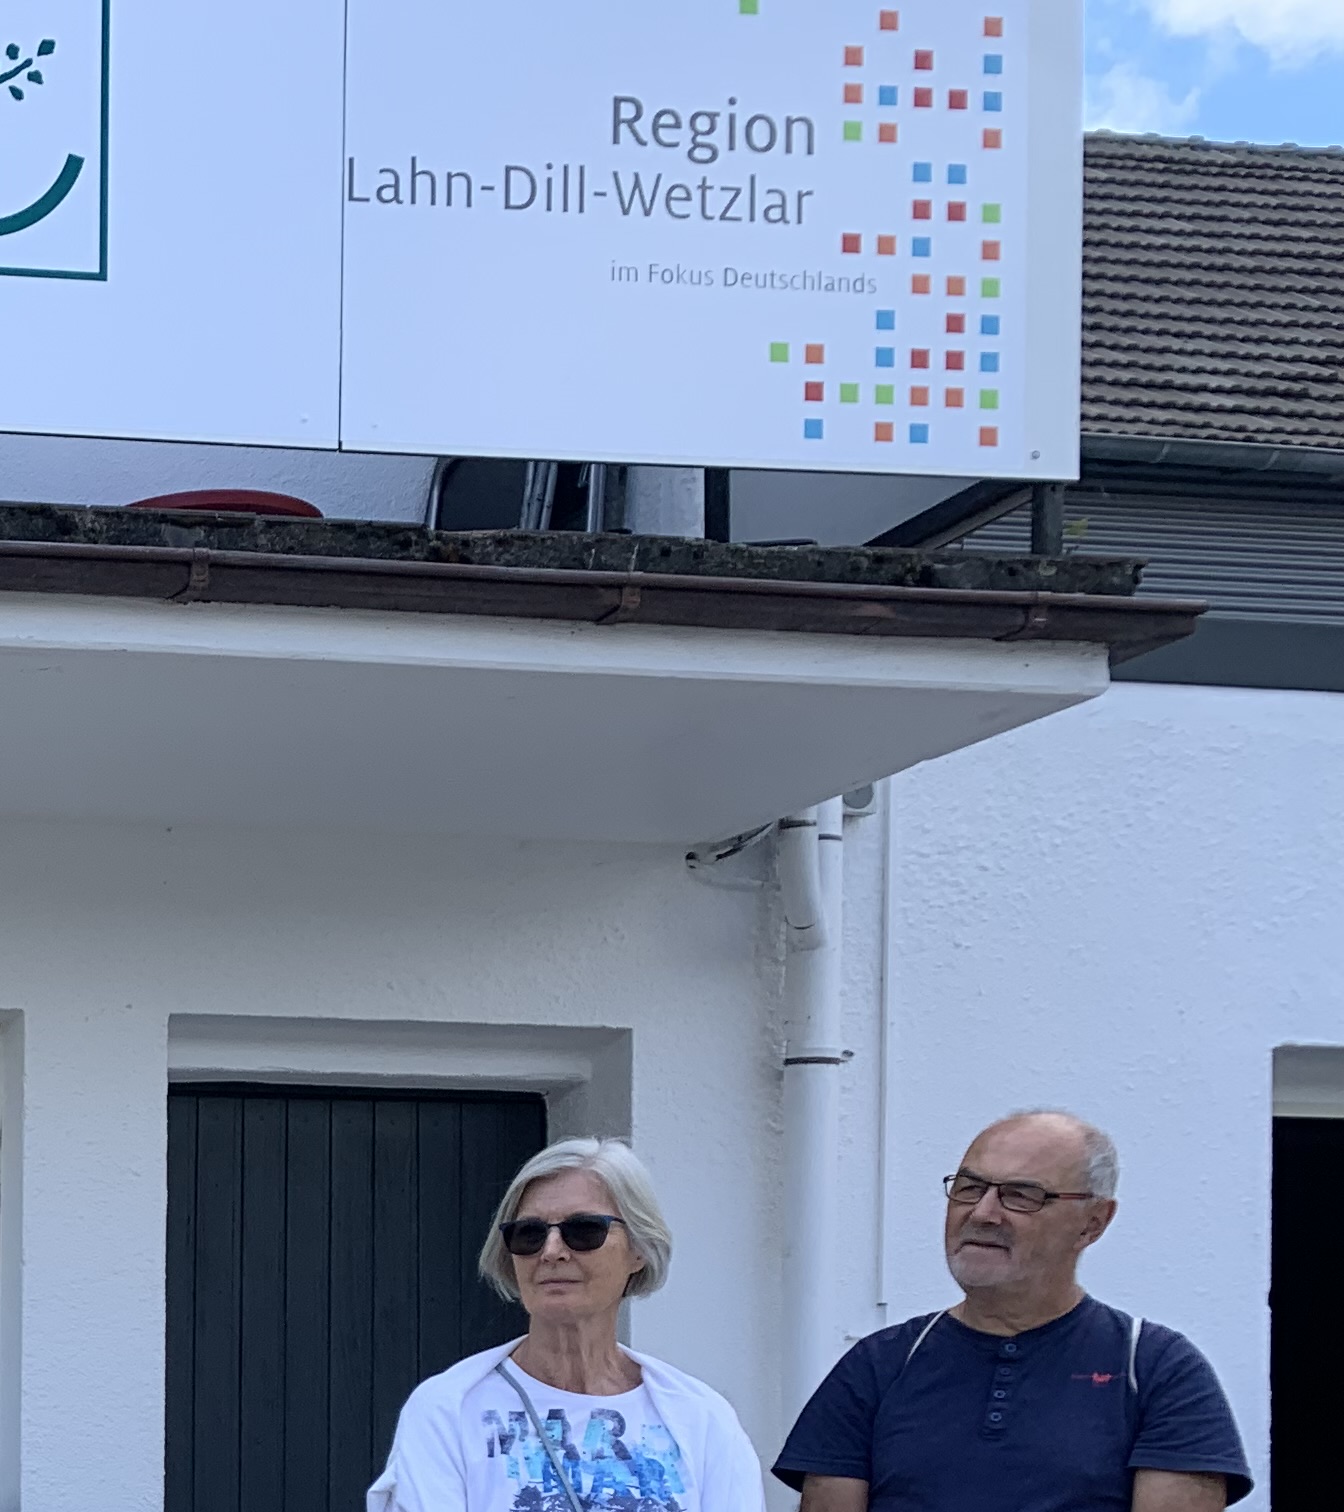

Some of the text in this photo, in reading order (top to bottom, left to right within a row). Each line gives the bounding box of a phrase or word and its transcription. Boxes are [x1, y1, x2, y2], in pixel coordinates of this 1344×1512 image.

[611, 97, 816, 163] Region
[346, 157, 814, 226] Lahn-Dill-Wetzlar
[610, 260, 878, 296] im Fokus Deutschlands
